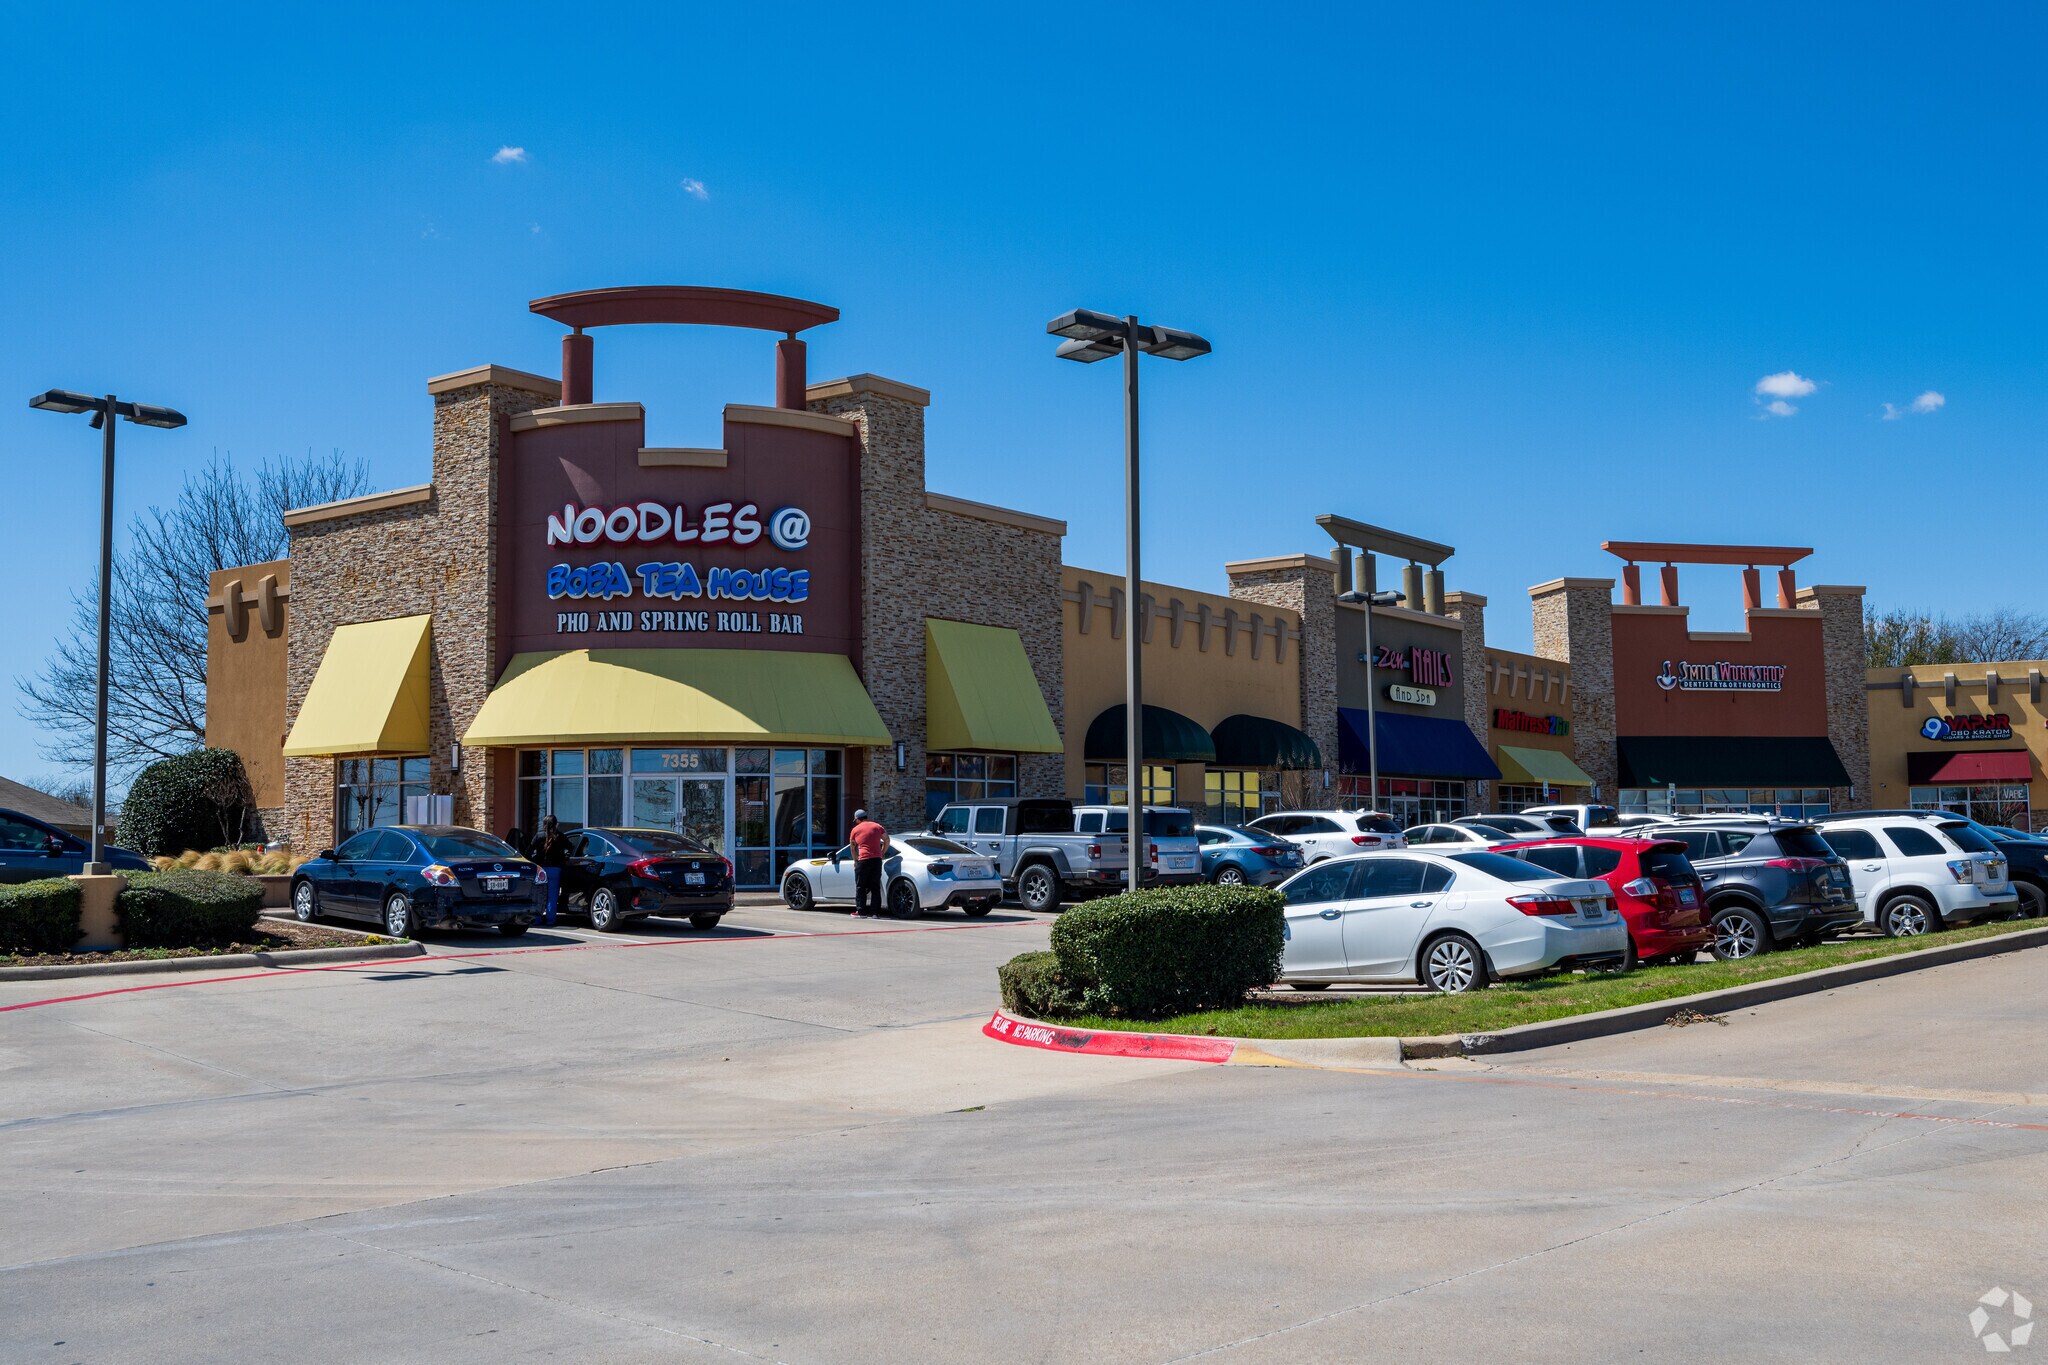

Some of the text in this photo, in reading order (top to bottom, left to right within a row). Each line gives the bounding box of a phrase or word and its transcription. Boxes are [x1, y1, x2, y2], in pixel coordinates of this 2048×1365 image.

[547, 501, 811, 551] NOODLES @
[547, 561, 811, 603] BOBA TEA HOUSE
[556, 611, 804, 634] PHO AND SPRING ROLL BAR
[1411, 645, 1453, 688] NAILS
[1945, 714, 2010, 730] VAPOR
[661, 753, 699, 769] 7355
[2003, 788, 2024, 800] VAPE
[1021, 1026, 1055, 1044] PARKING
